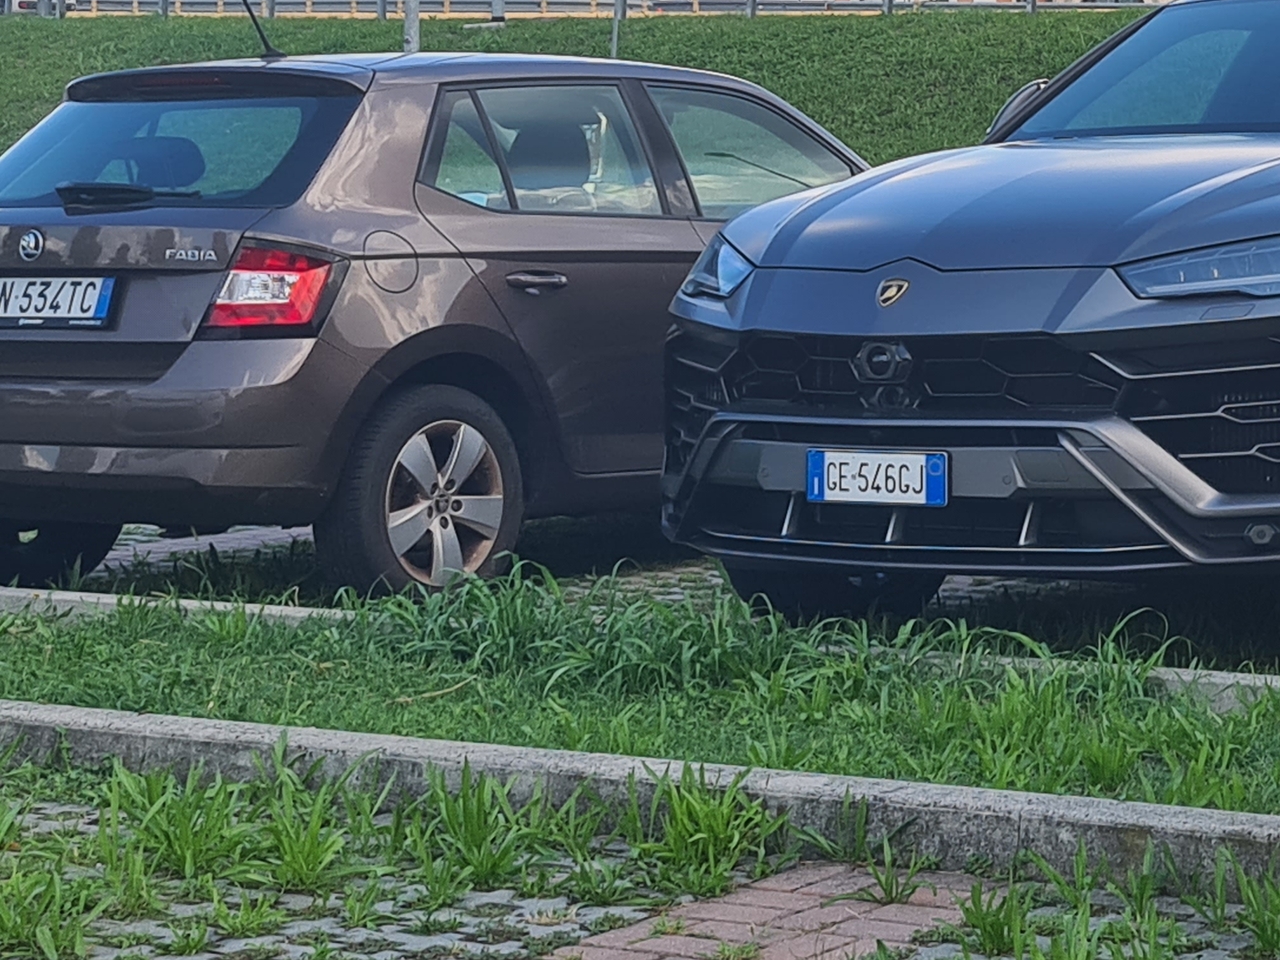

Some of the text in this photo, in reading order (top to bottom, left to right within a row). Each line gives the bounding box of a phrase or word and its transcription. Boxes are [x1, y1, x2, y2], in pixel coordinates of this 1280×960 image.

[165, 248, 218, 261] FABIA
[19, 281, 97, 314] 534TC
[857, 462, 924, 494] 546GJ
